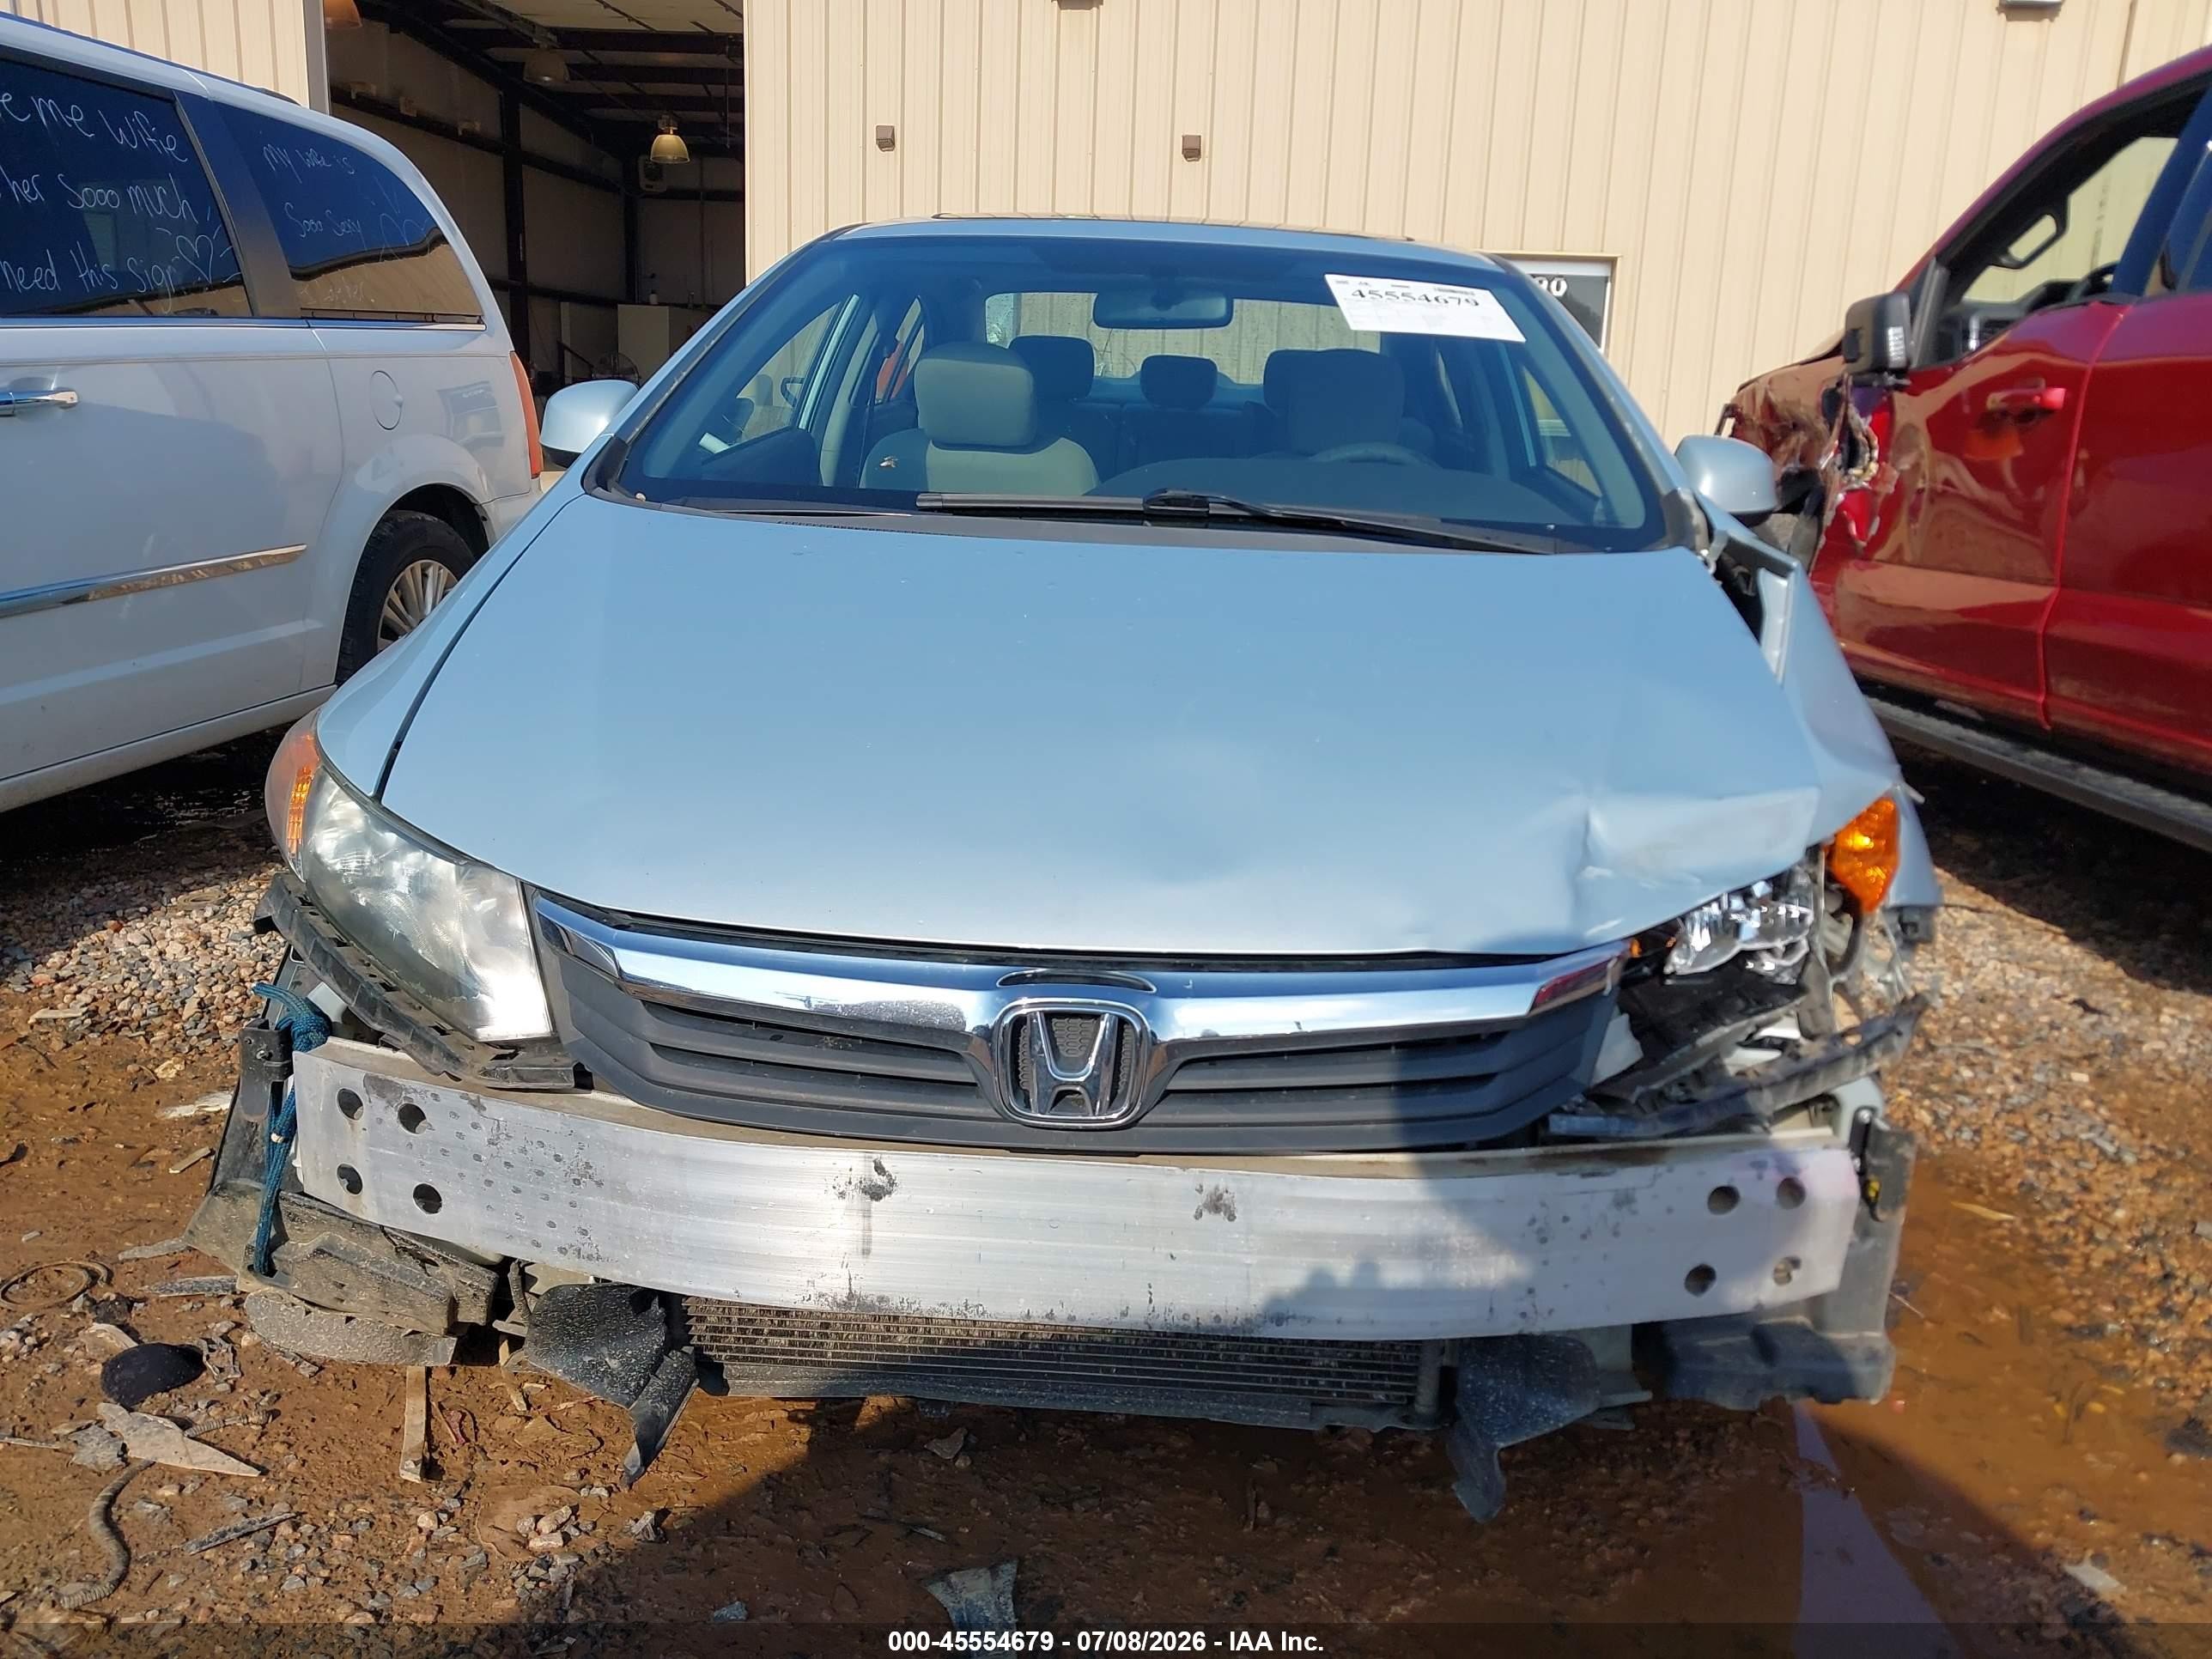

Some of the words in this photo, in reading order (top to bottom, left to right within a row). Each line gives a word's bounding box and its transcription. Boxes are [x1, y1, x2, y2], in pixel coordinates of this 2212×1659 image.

[0, 163, 45, 206] her
[70, 240, 118, 293] this
[1351, 288, 1480, 307] 45554679
